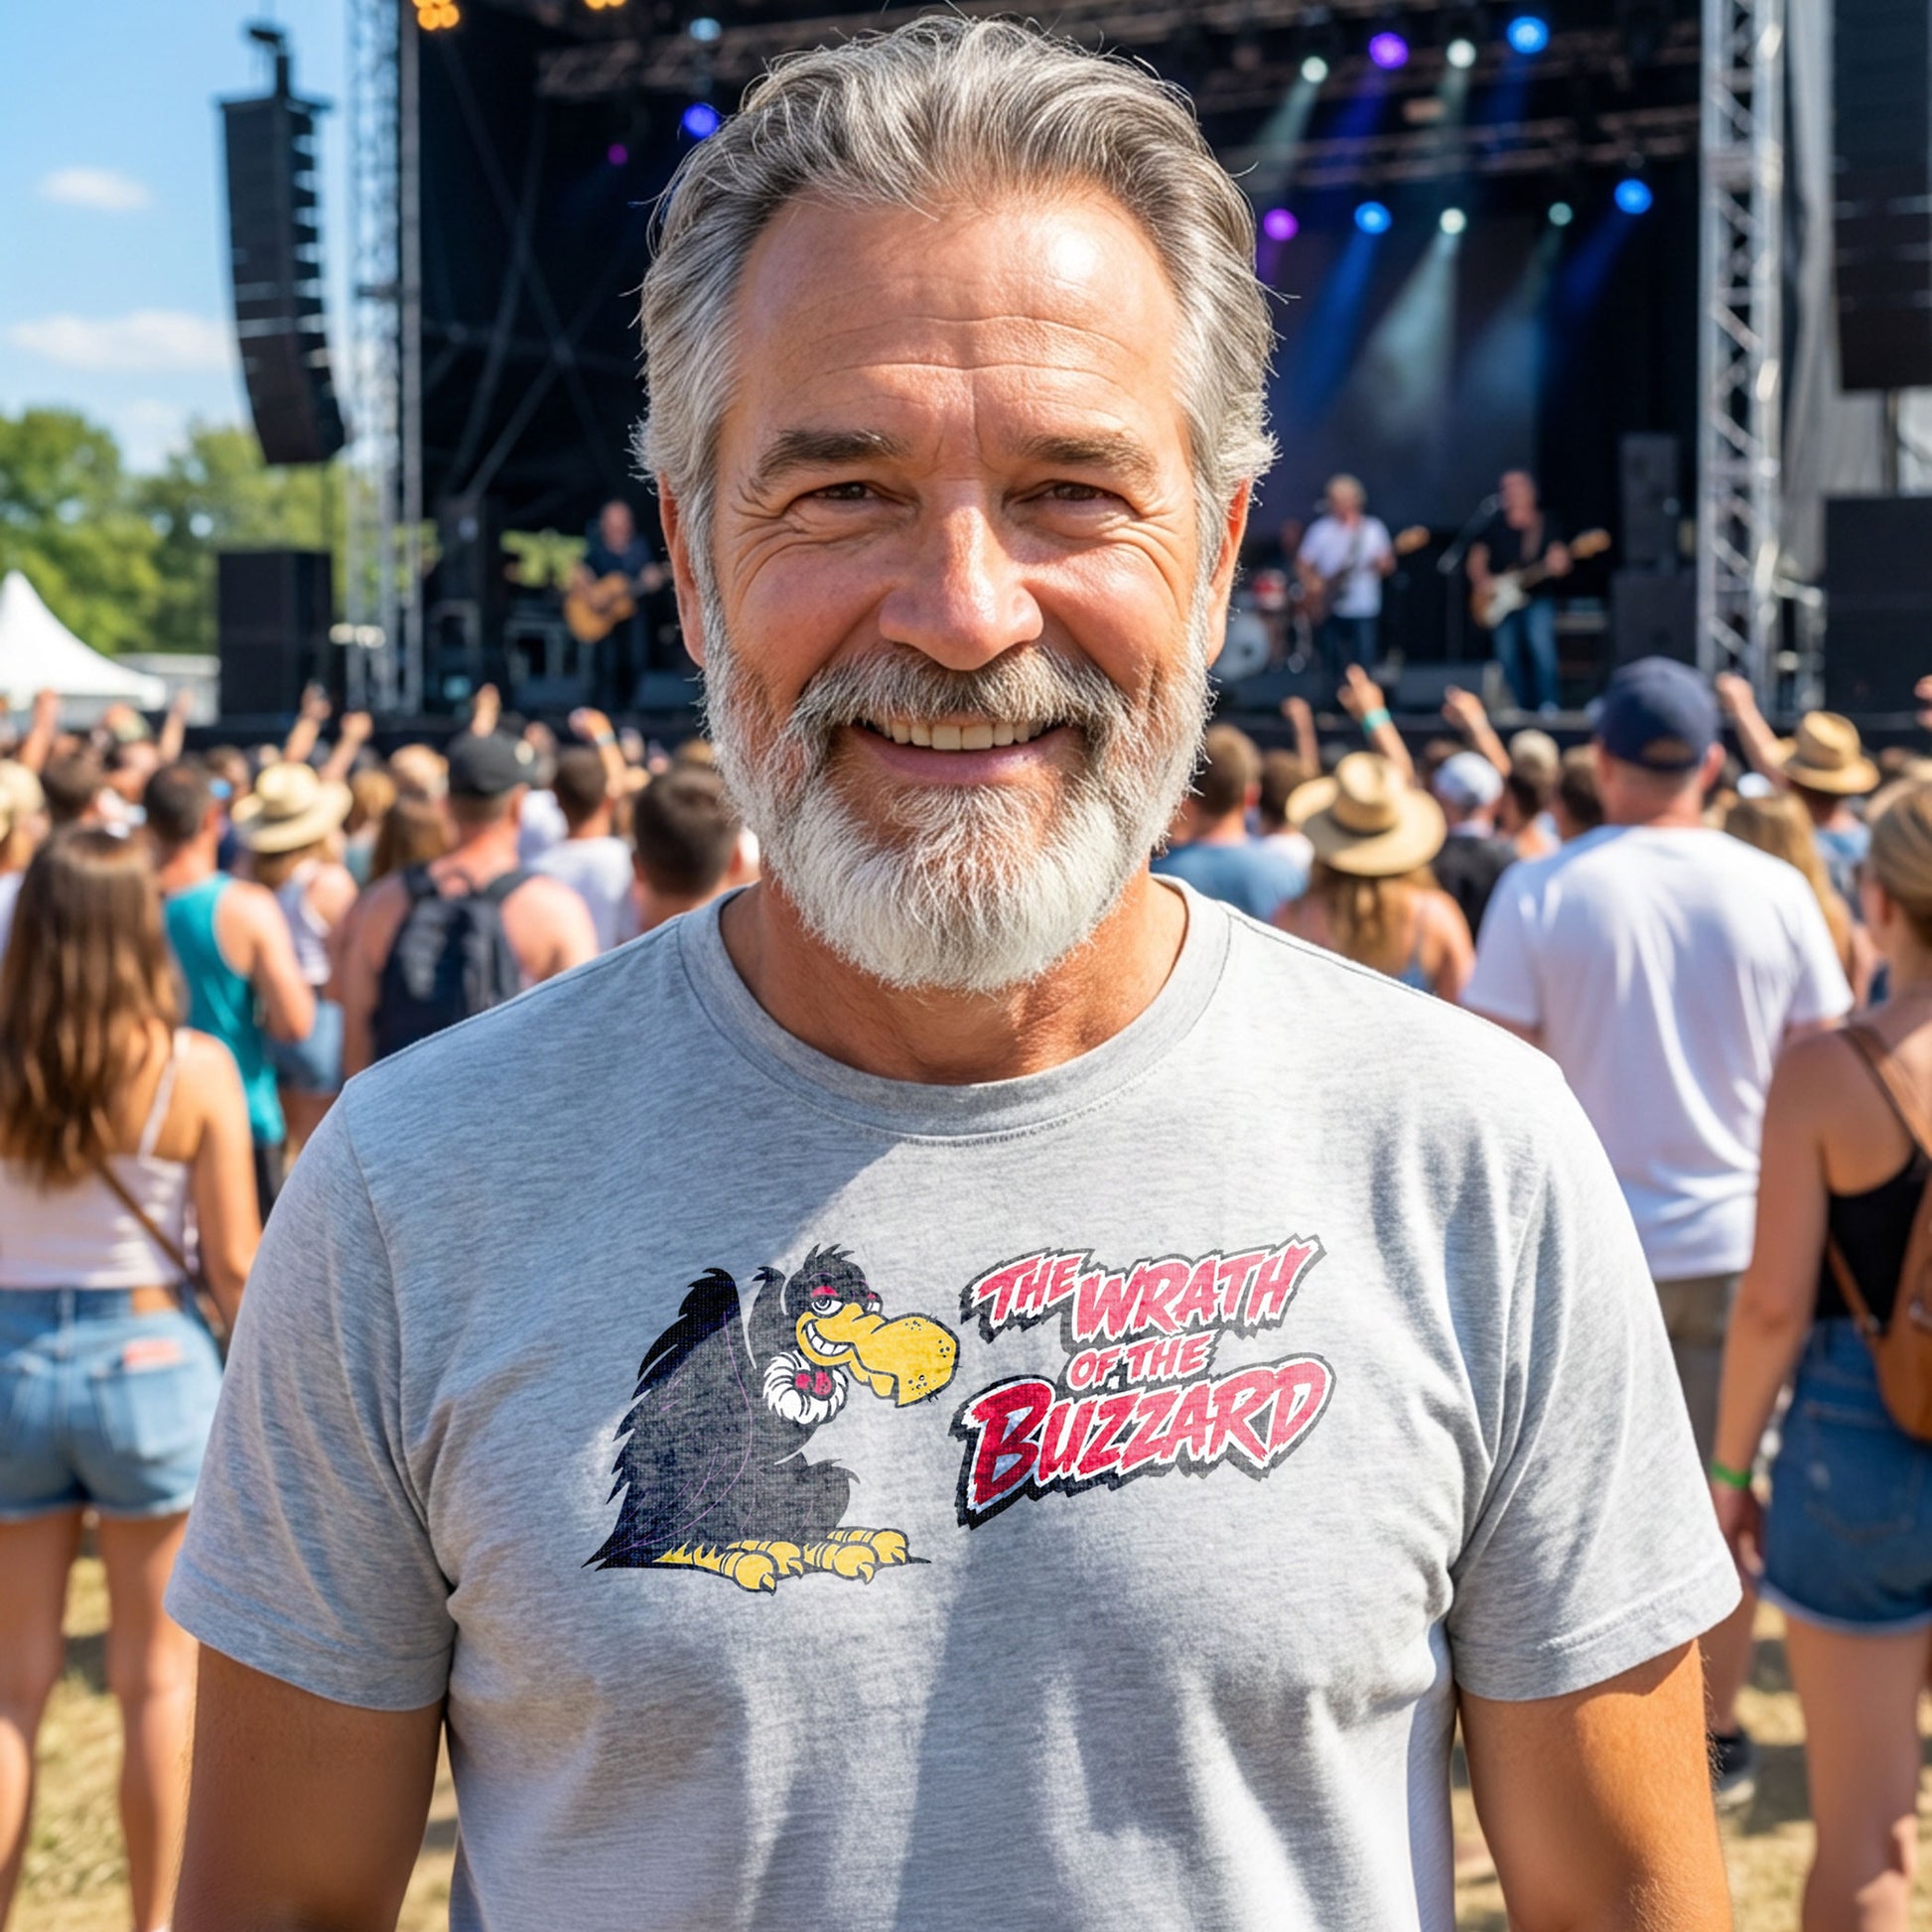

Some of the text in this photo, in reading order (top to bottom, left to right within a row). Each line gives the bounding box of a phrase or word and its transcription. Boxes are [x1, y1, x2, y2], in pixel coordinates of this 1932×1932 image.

[971, 1239, 1319, 1342] THE WRATH
[1066, 1329, 1219, 1390] OF THE
[960, 1356, 1332, 1513] BUZZARD
